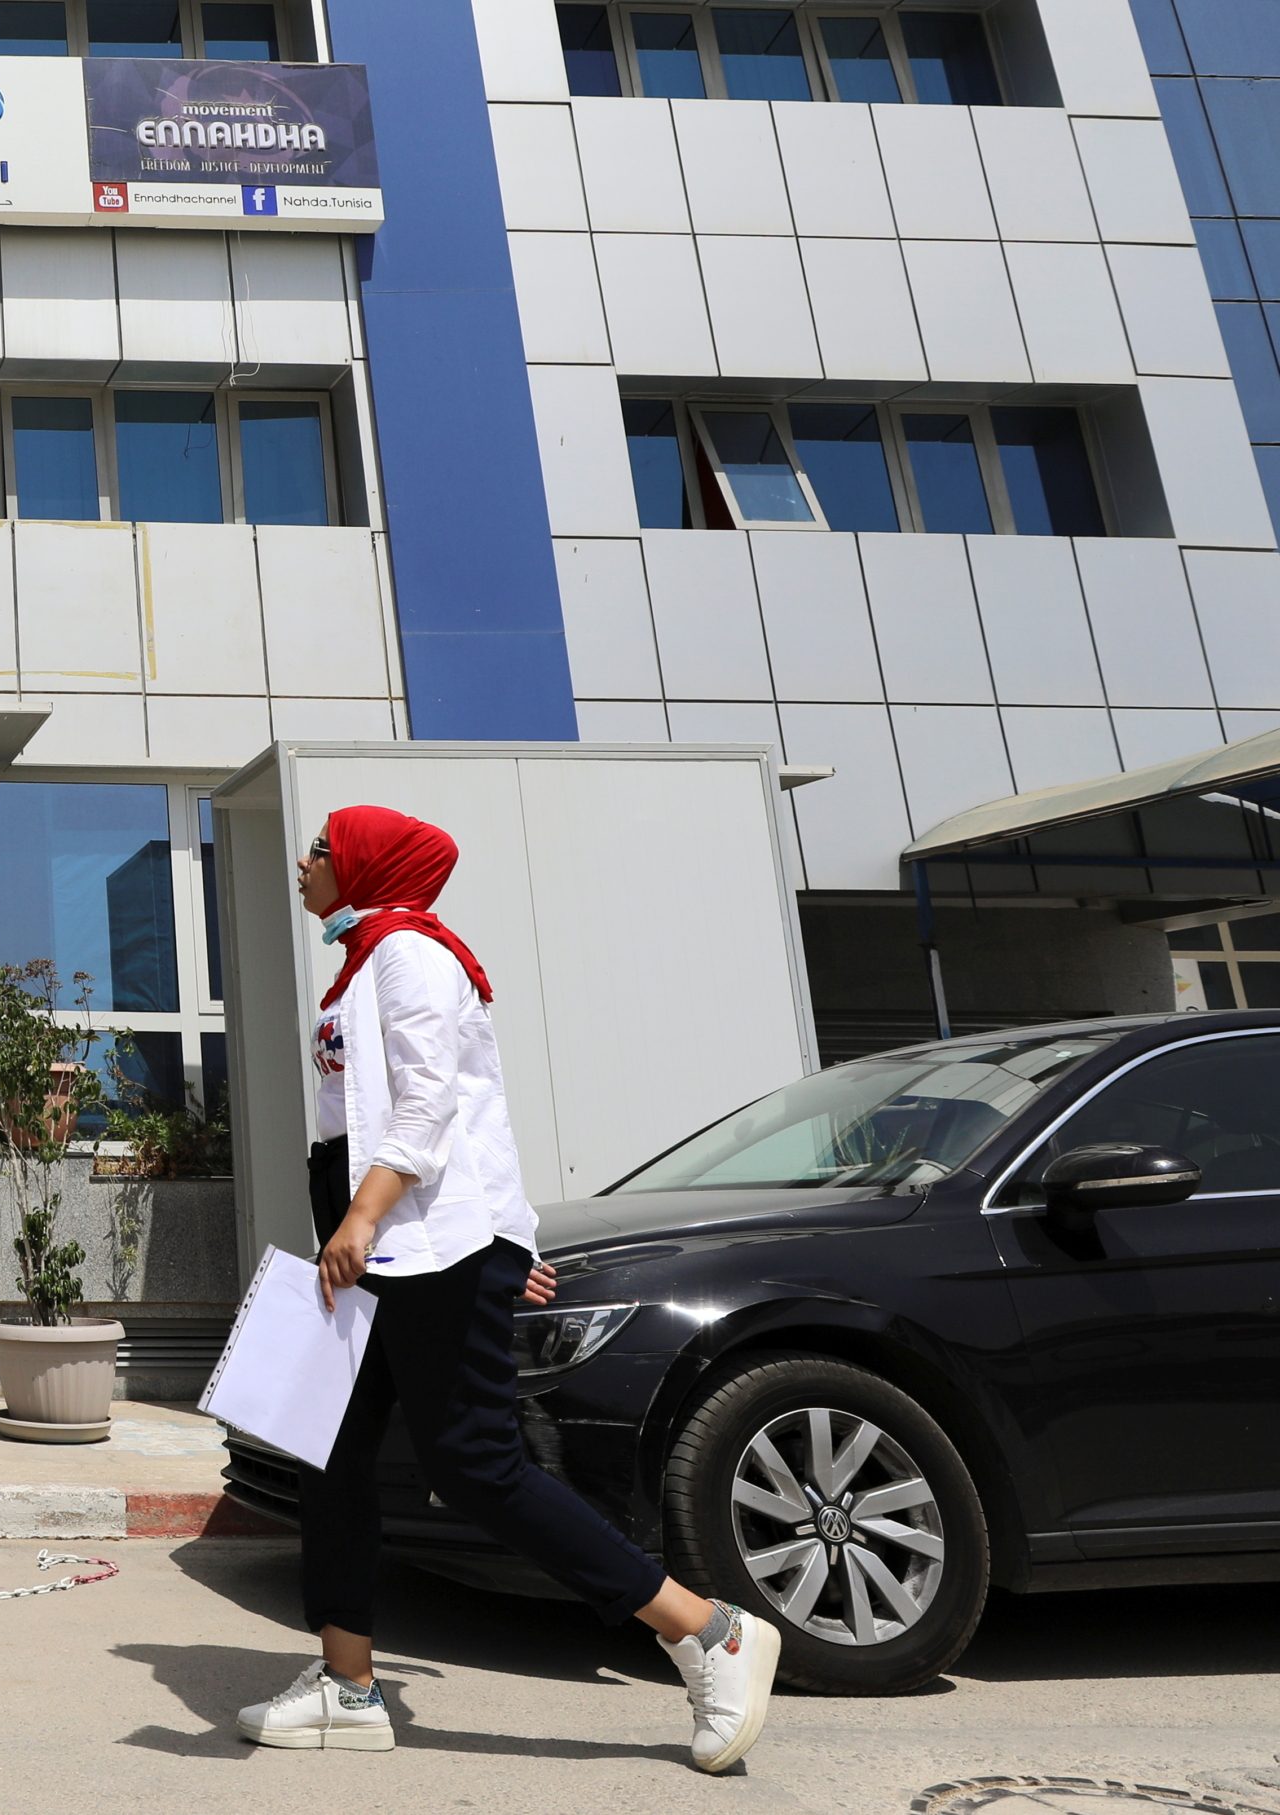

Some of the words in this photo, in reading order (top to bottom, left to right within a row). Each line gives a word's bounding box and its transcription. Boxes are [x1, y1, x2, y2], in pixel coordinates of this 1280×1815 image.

[183, 104, 274, 117] movement
[102, 185, 118, 195] You
[102, 197, 120, 206] Tube
[134, 193, 237, 205] Ennahdhachannel
[283, 196, 373, 209] Nahda.Tunisia
